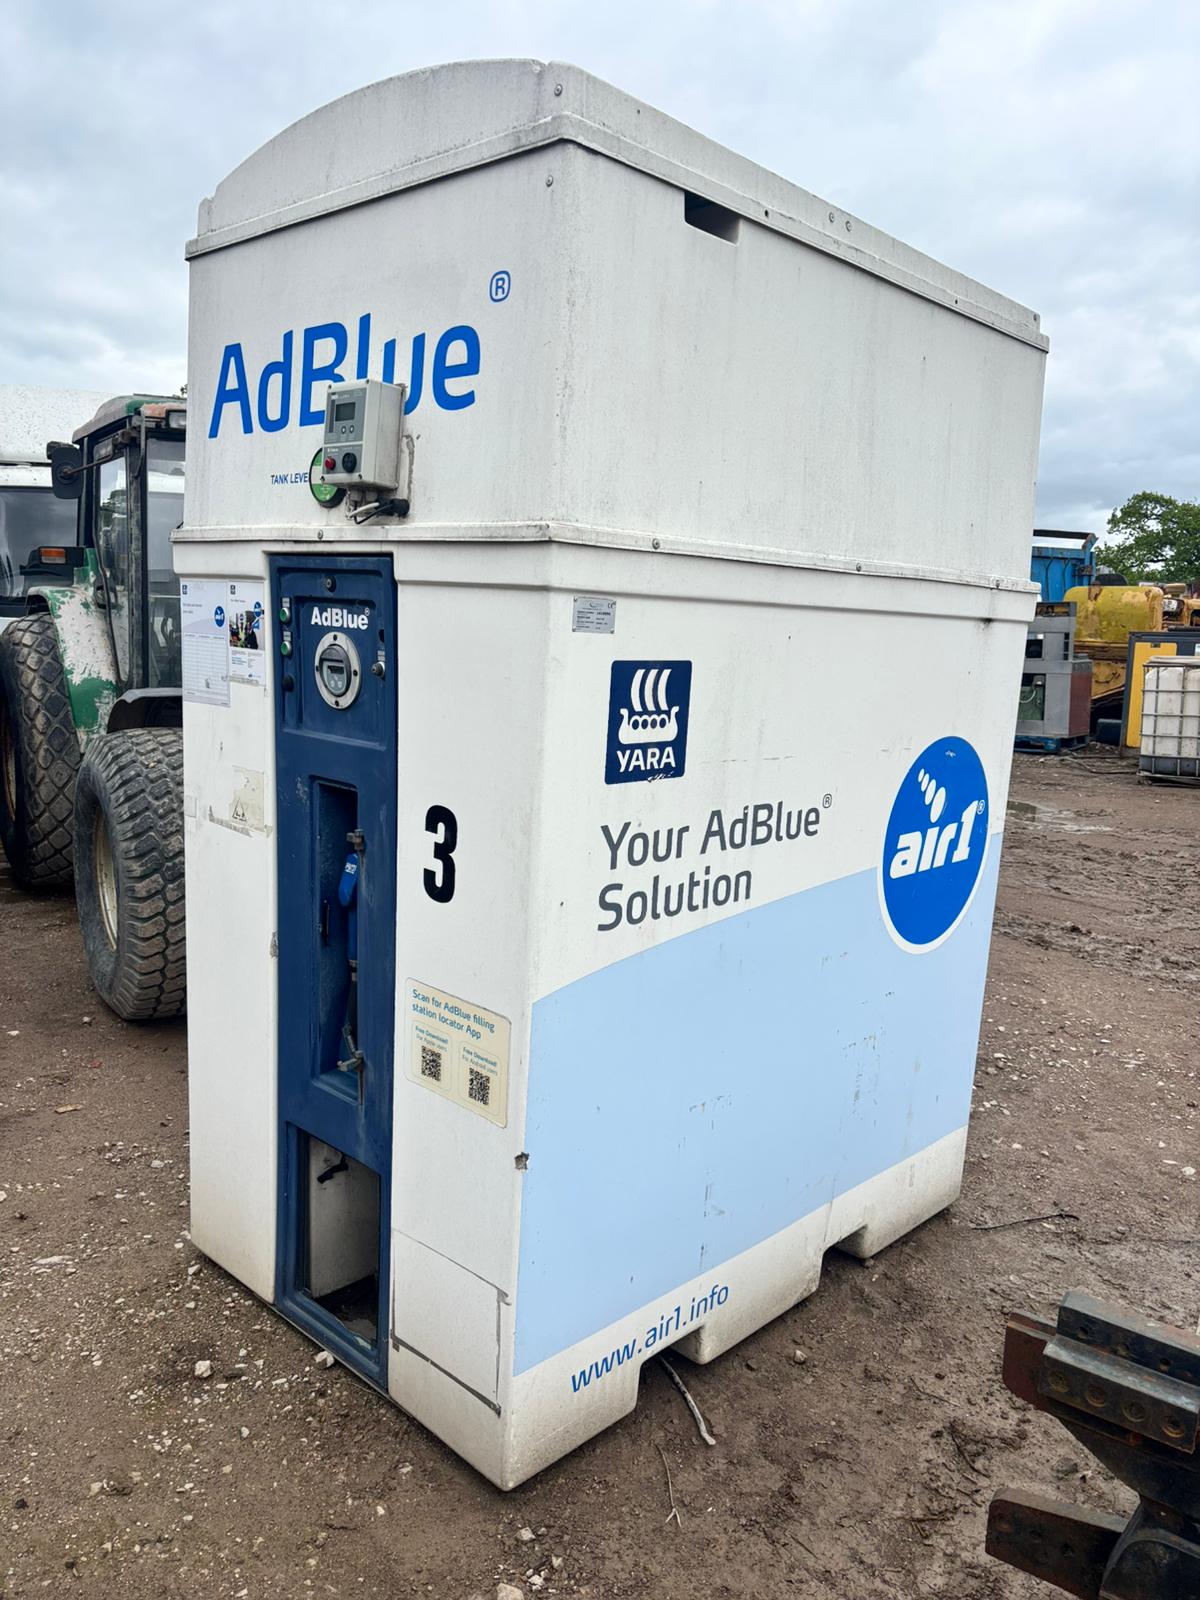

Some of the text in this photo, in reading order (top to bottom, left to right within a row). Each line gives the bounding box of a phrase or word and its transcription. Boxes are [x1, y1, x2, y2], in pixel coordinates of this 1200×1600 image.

[208, 312, 481, 439] AdBlue
[270, 472, 309, 485] TANK LEVE
[616, 746, 677, 773] YARA
[423, 804, 458, 904] 3
[600, 821, 690, 870] Your
[597, 865, 752, 932] Solution
[412, 989, 495, 1034] Scan for AdBlue filling
[412, 1003, 482, 1040] station locator App
[571, 1284, 729, 1393] www.air1.info
